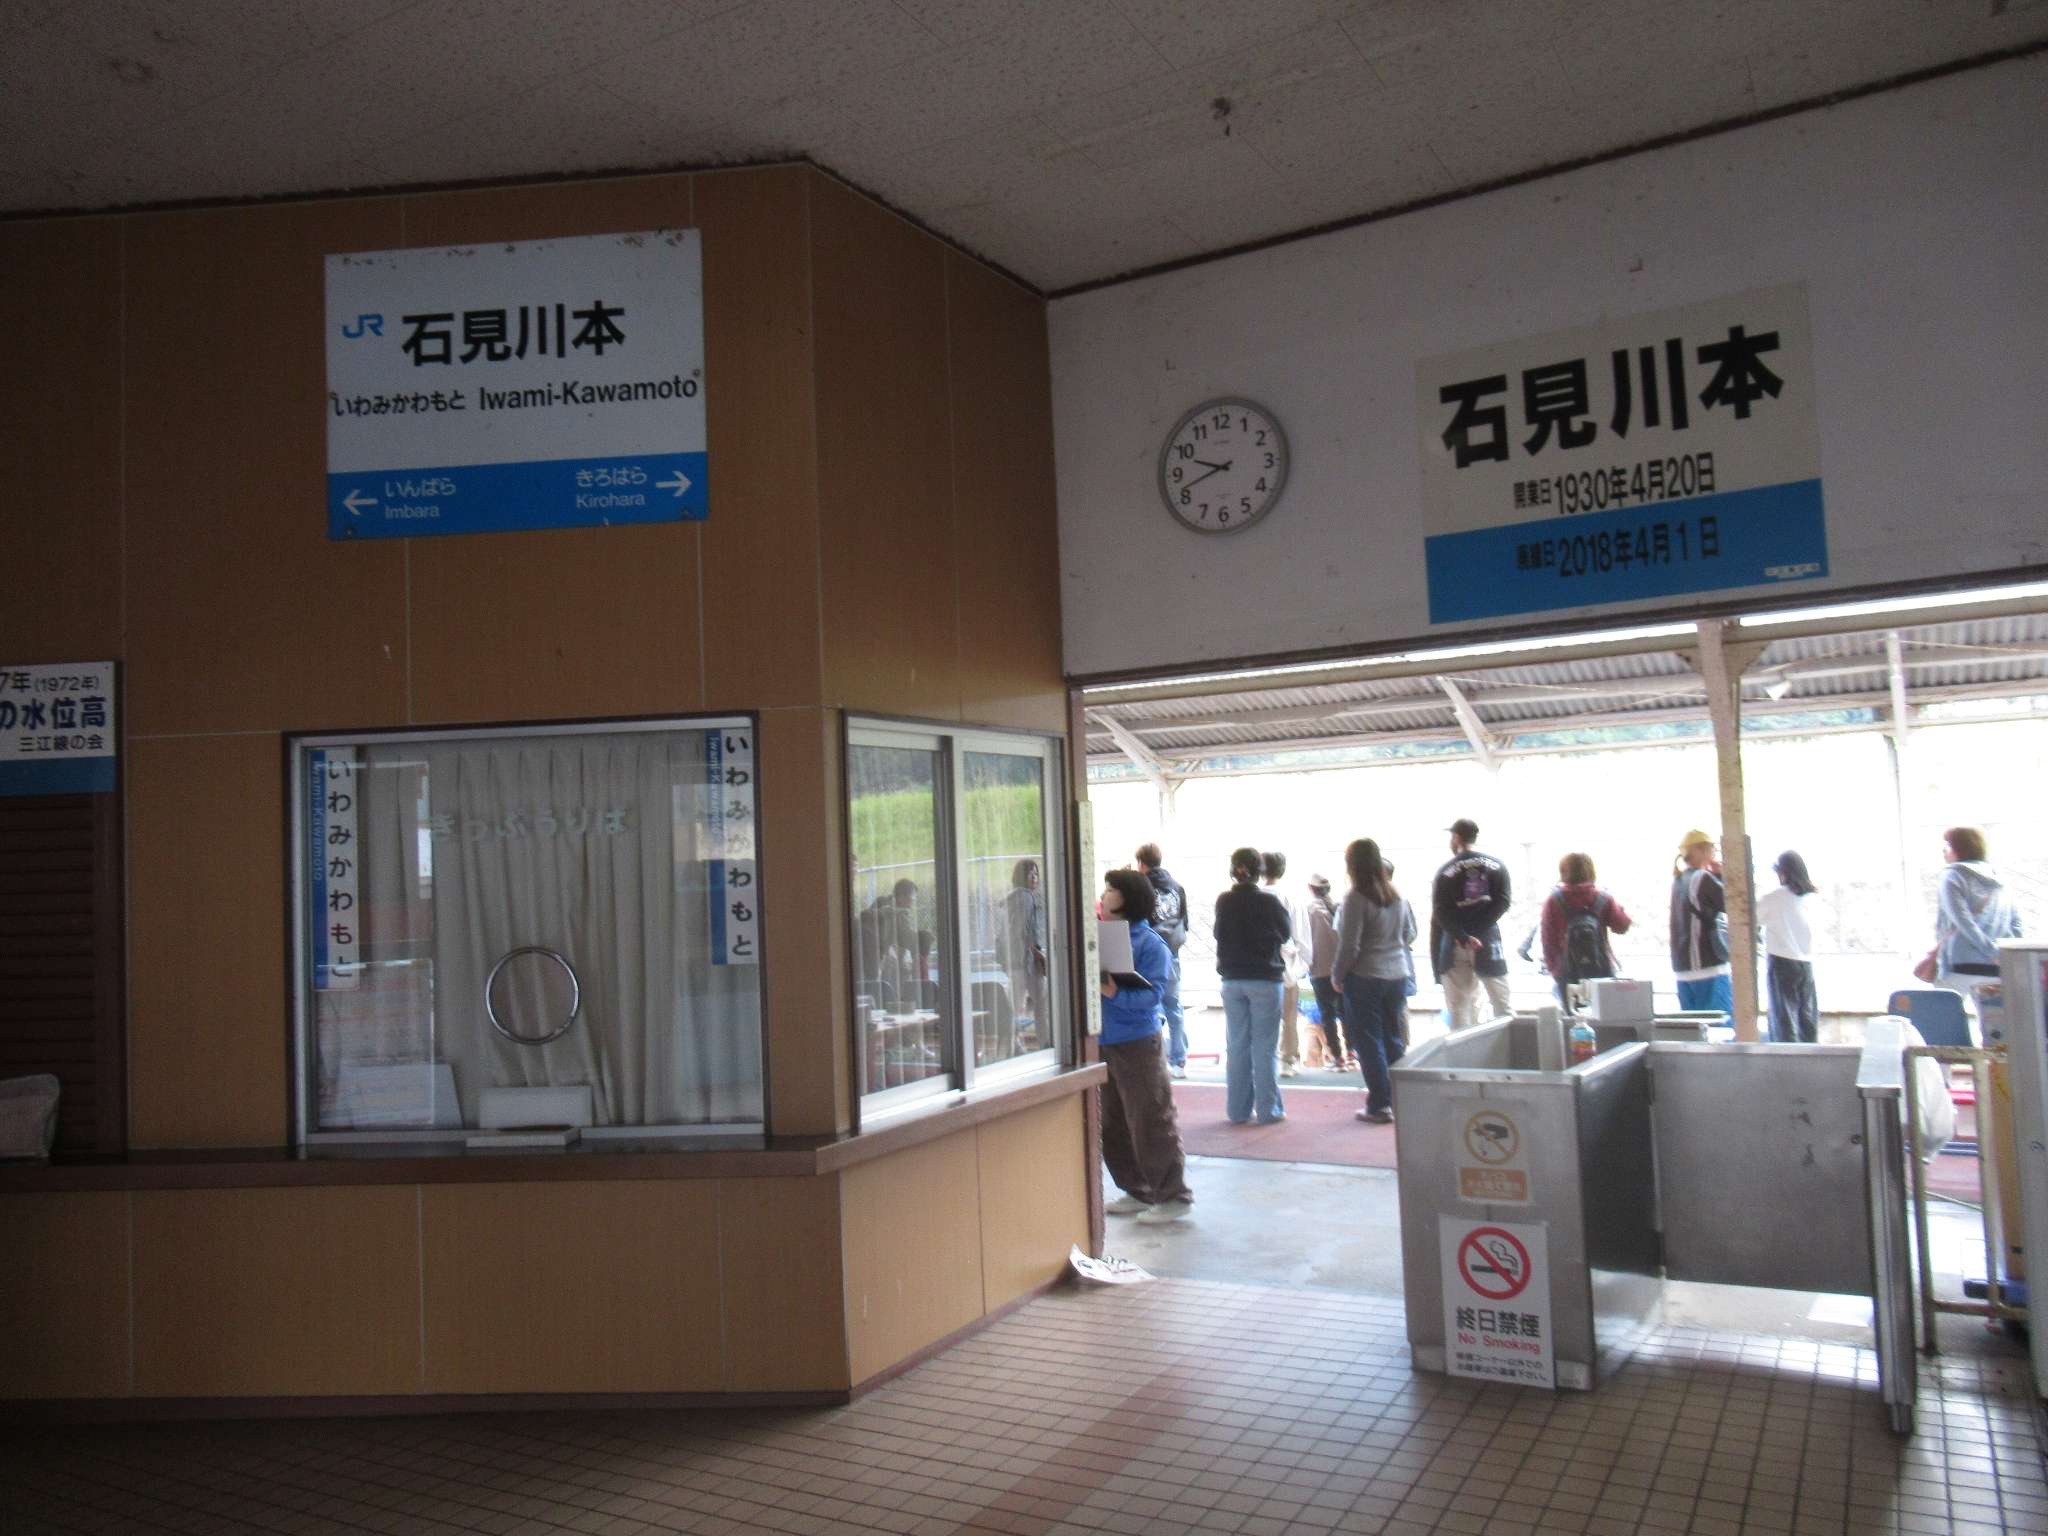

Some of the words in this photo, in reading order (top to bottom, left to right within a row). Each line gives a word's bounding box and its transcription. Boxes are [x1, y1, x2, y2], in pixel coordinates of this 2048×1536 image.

[342, 313, 384, 339] JR
[402, 300, 625, 367] 石見川本
[480, 374, 698, 411] Iwami-Kawamoto
[1439, 325, 1784, 469] 石見川本
[334, 391, 466, 418] いわみかわもと
[1213, 414, 1230, 430] 12
[1240, 417, 1248, 432] 1
[1193, 424, 1207, 441] 11
[1255, 430, 1266, 446] 2
[1178, 443, 1194, 460] 10
[1264, 452, 1274, 469] 3
[576, 466, 648, 488] きろはら
[1172, 467, 1183, 483] 9
[385, 477, 457, 498] いんばら
[1255, 477, 1266, 492] 4
[576, 492, 645, 509] Kirohara
[1180, 488, 1191, 505] 8
[1241, 497, 1251, 513] 5
[385, 504, 440, 521] Imbara
[1199, 503, 1208, 519] 7
[1218, 506, 1229, 522] 6
[726, 736, 753, 956] いわみかわもと
[328, 760, 353, 978] いわみかわもと
[1456, 1306, 1541, 1338] 終日禁煙
[1458, 1332, 1476, 1345] No
[1482, 1335, 1541, 1355] Smoking
